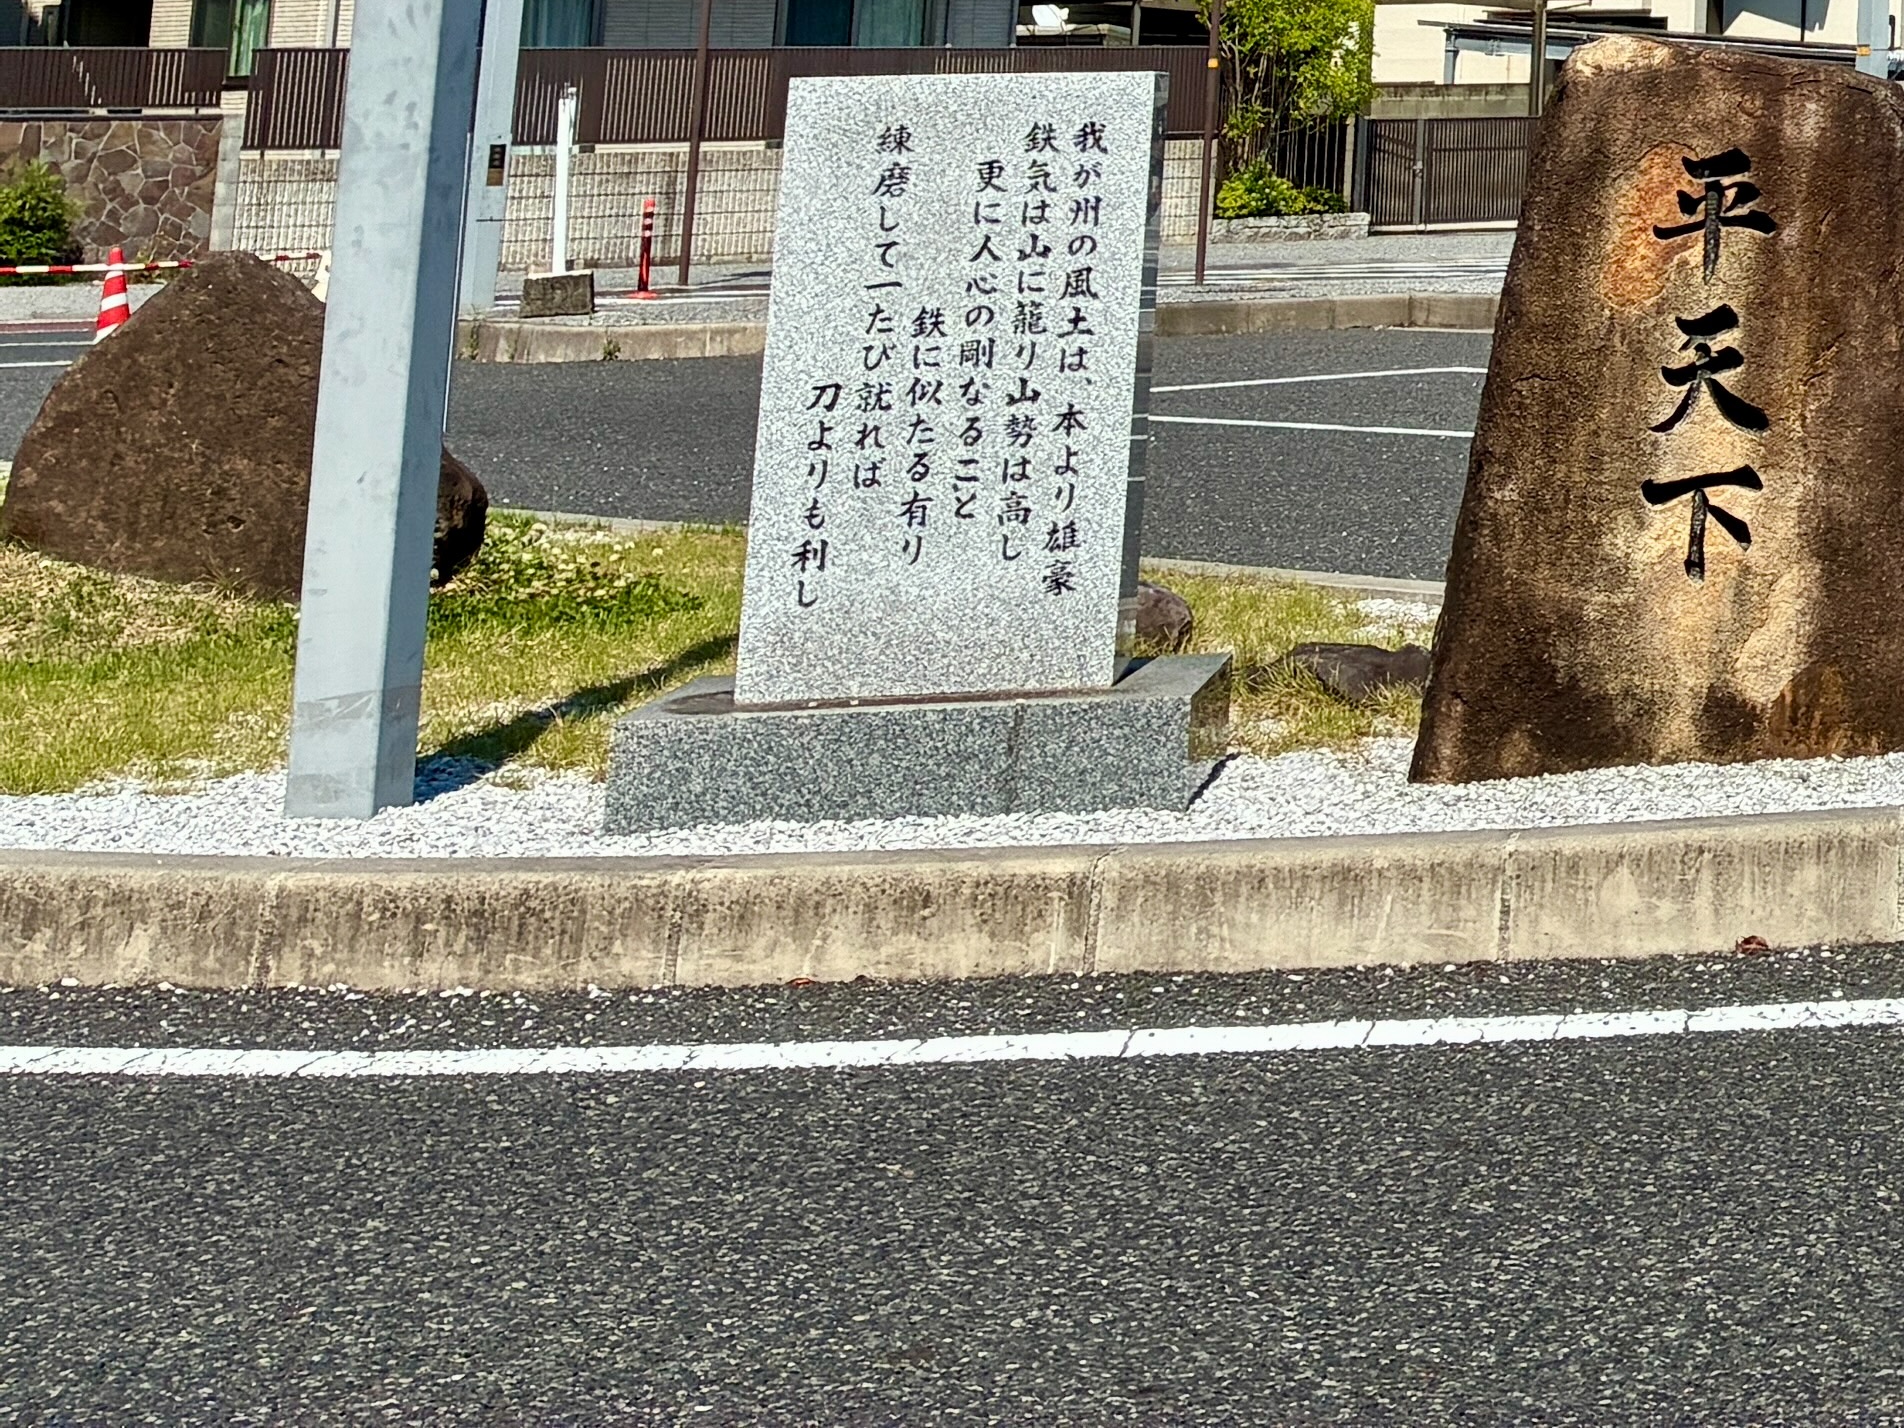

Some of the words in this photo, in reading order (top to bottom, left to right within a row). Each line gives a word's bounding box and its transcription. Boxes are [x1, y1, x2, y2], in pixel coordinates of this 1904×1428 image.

[900, 306, 948, 566] 鉄に似たる有り
[953, 159, 1008, 520] 更に人心の剛なること
[1641, 147, 1777, 582] 平天下
[791, 382, 842, 609] 刀よりも利し
